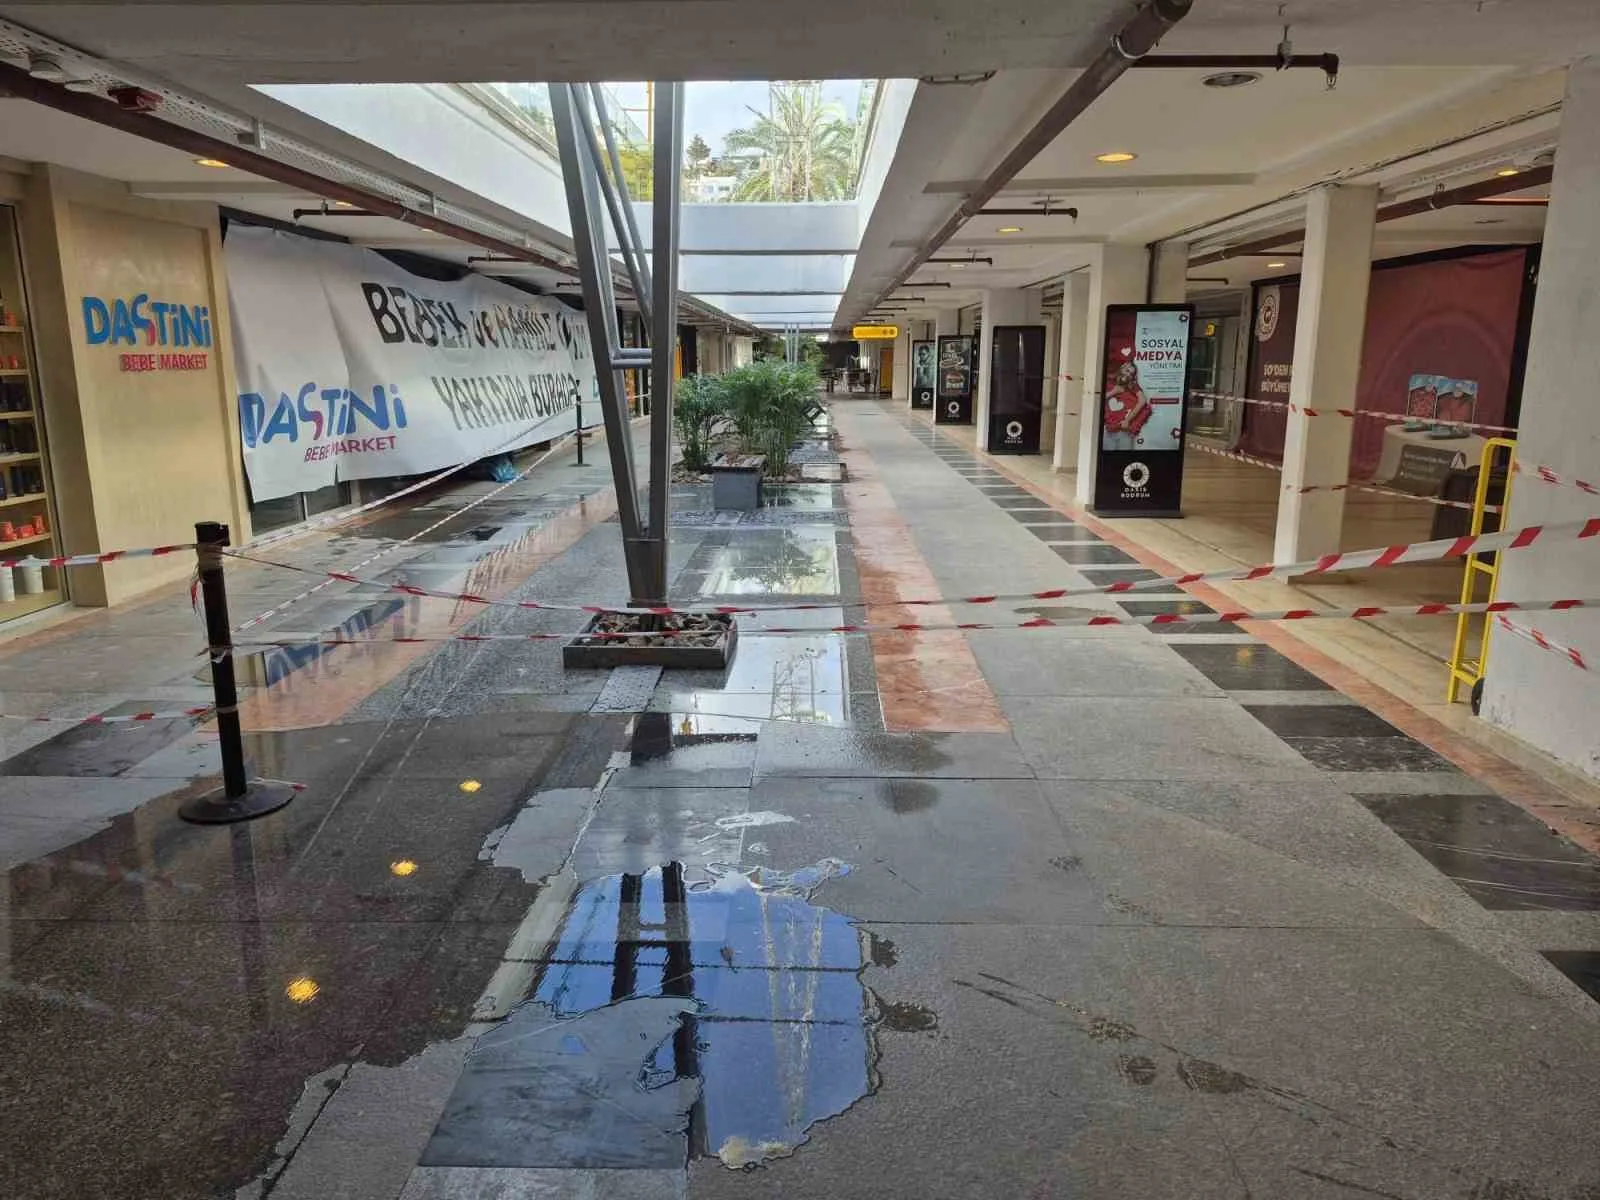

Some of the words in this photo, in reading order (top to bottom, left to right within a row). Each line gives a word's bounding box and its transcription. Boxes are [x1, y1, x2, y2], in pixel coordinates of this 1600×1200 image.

[1142, 338, 1184, 349] SOSYAL
[1136, 350, 1182, 361] MEDYA
[120, 354, 155, 371] BEBE
[158, 354, 208, 370] MARKET
